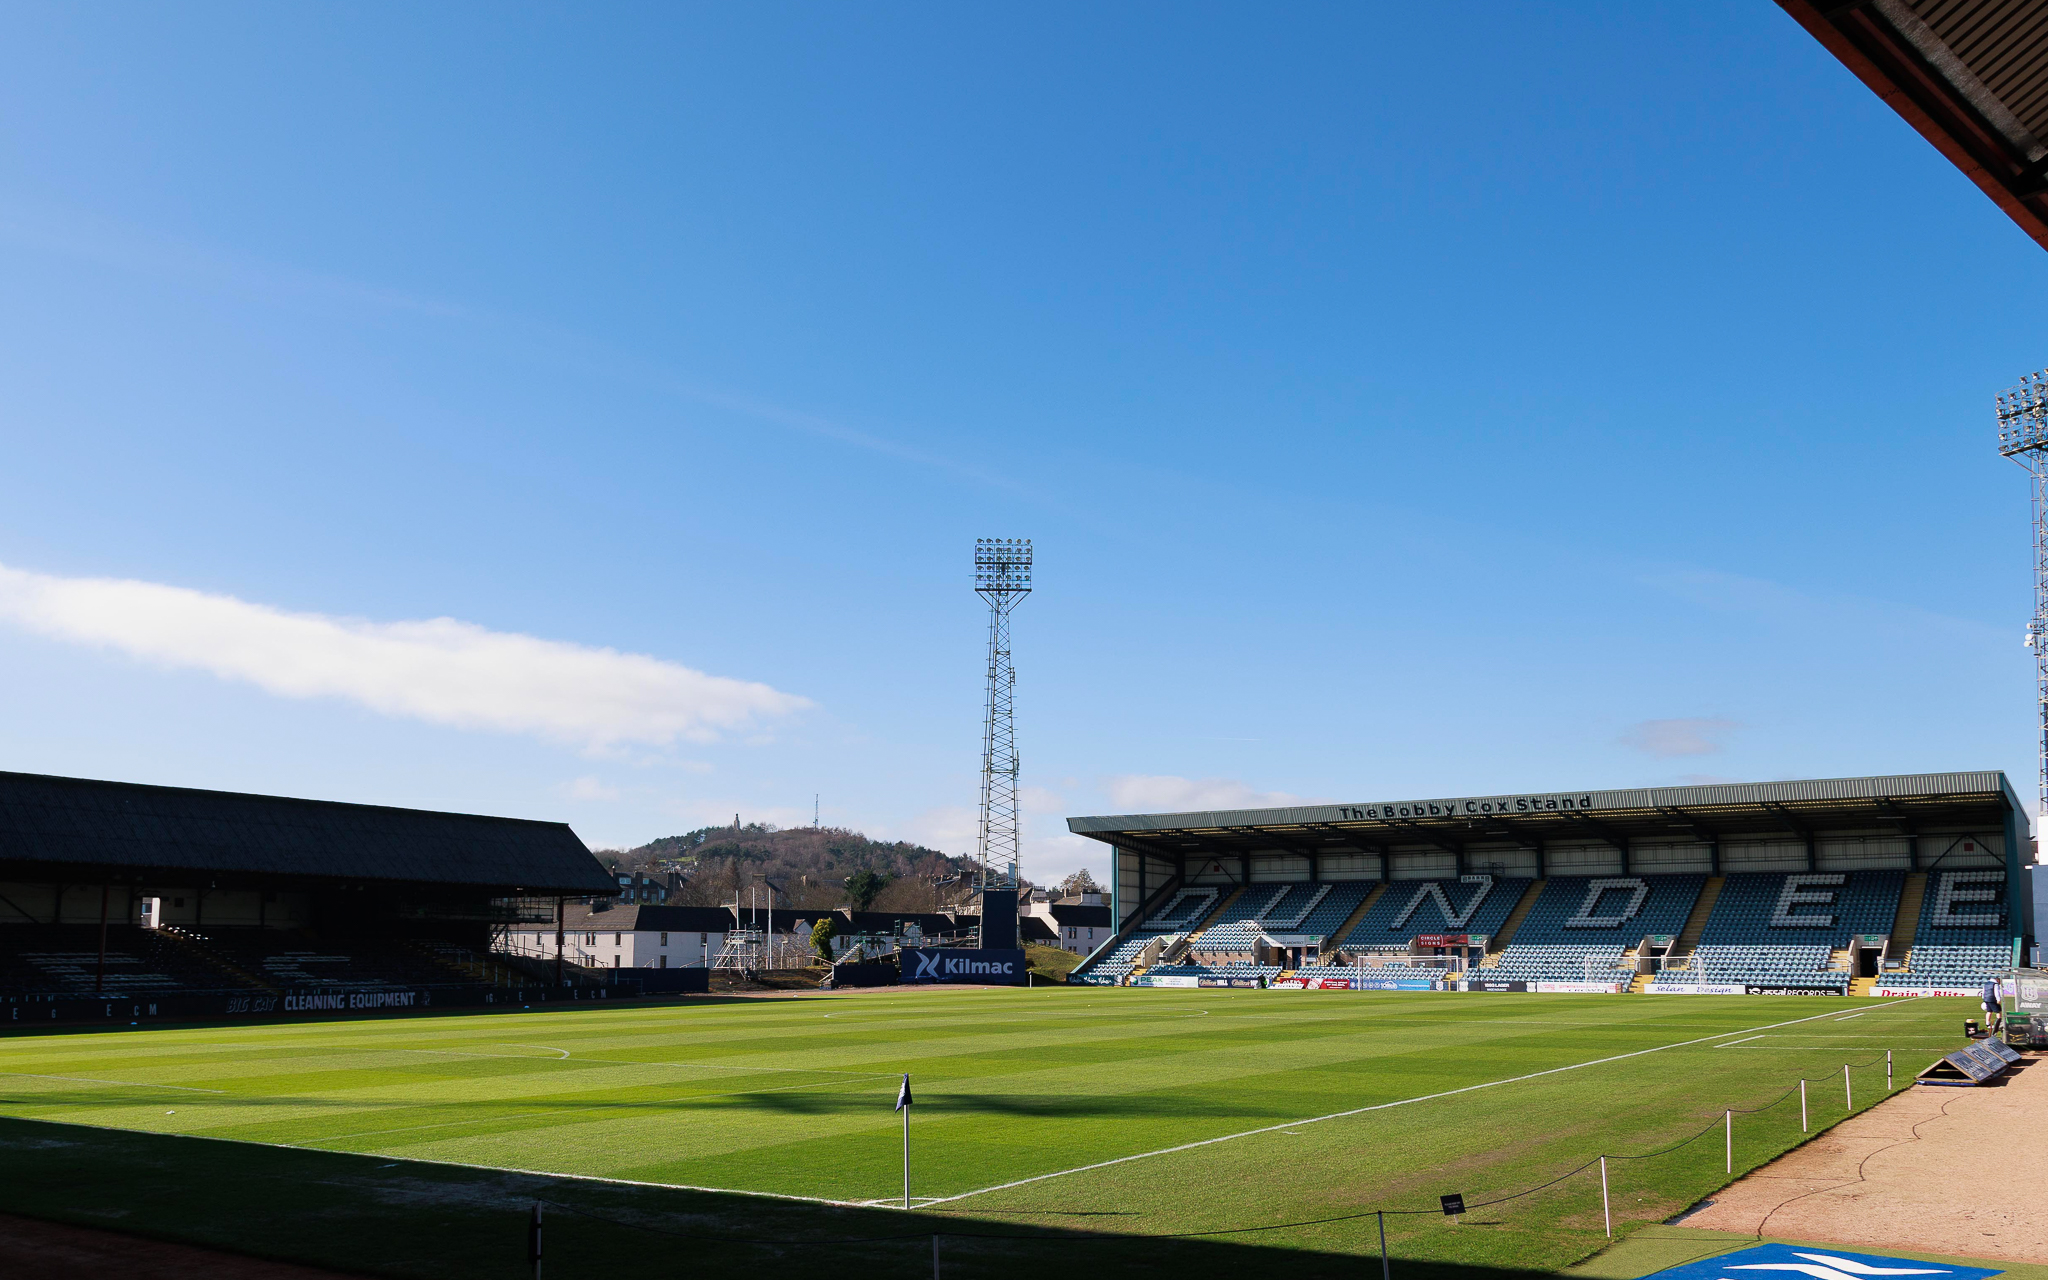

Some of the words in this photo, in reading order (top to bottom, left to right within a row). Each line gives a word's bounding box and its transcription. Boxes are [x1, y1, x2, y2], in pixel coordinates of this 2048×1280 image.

[1340, 807, 1378, 820] The
[1384, 803, 1455, 820] Bobby
[1465, 801, 1508, 813] Cox
[1516, 796, 1592, 811] Stand
[945, 958, 1013, 974] Kilmac
[1762, 987, 1787, 996] assai
[1881, 989, 1919, 997] Drain
[1934, 989, 1966, 997] Blitz
[226, 997, 250, 1013] BIG
[252, 996, 278, 1012] CAT
[284, 995, 345, 1011] CLEANING
[350, 992, 416, 1009] EQUIPMENT
